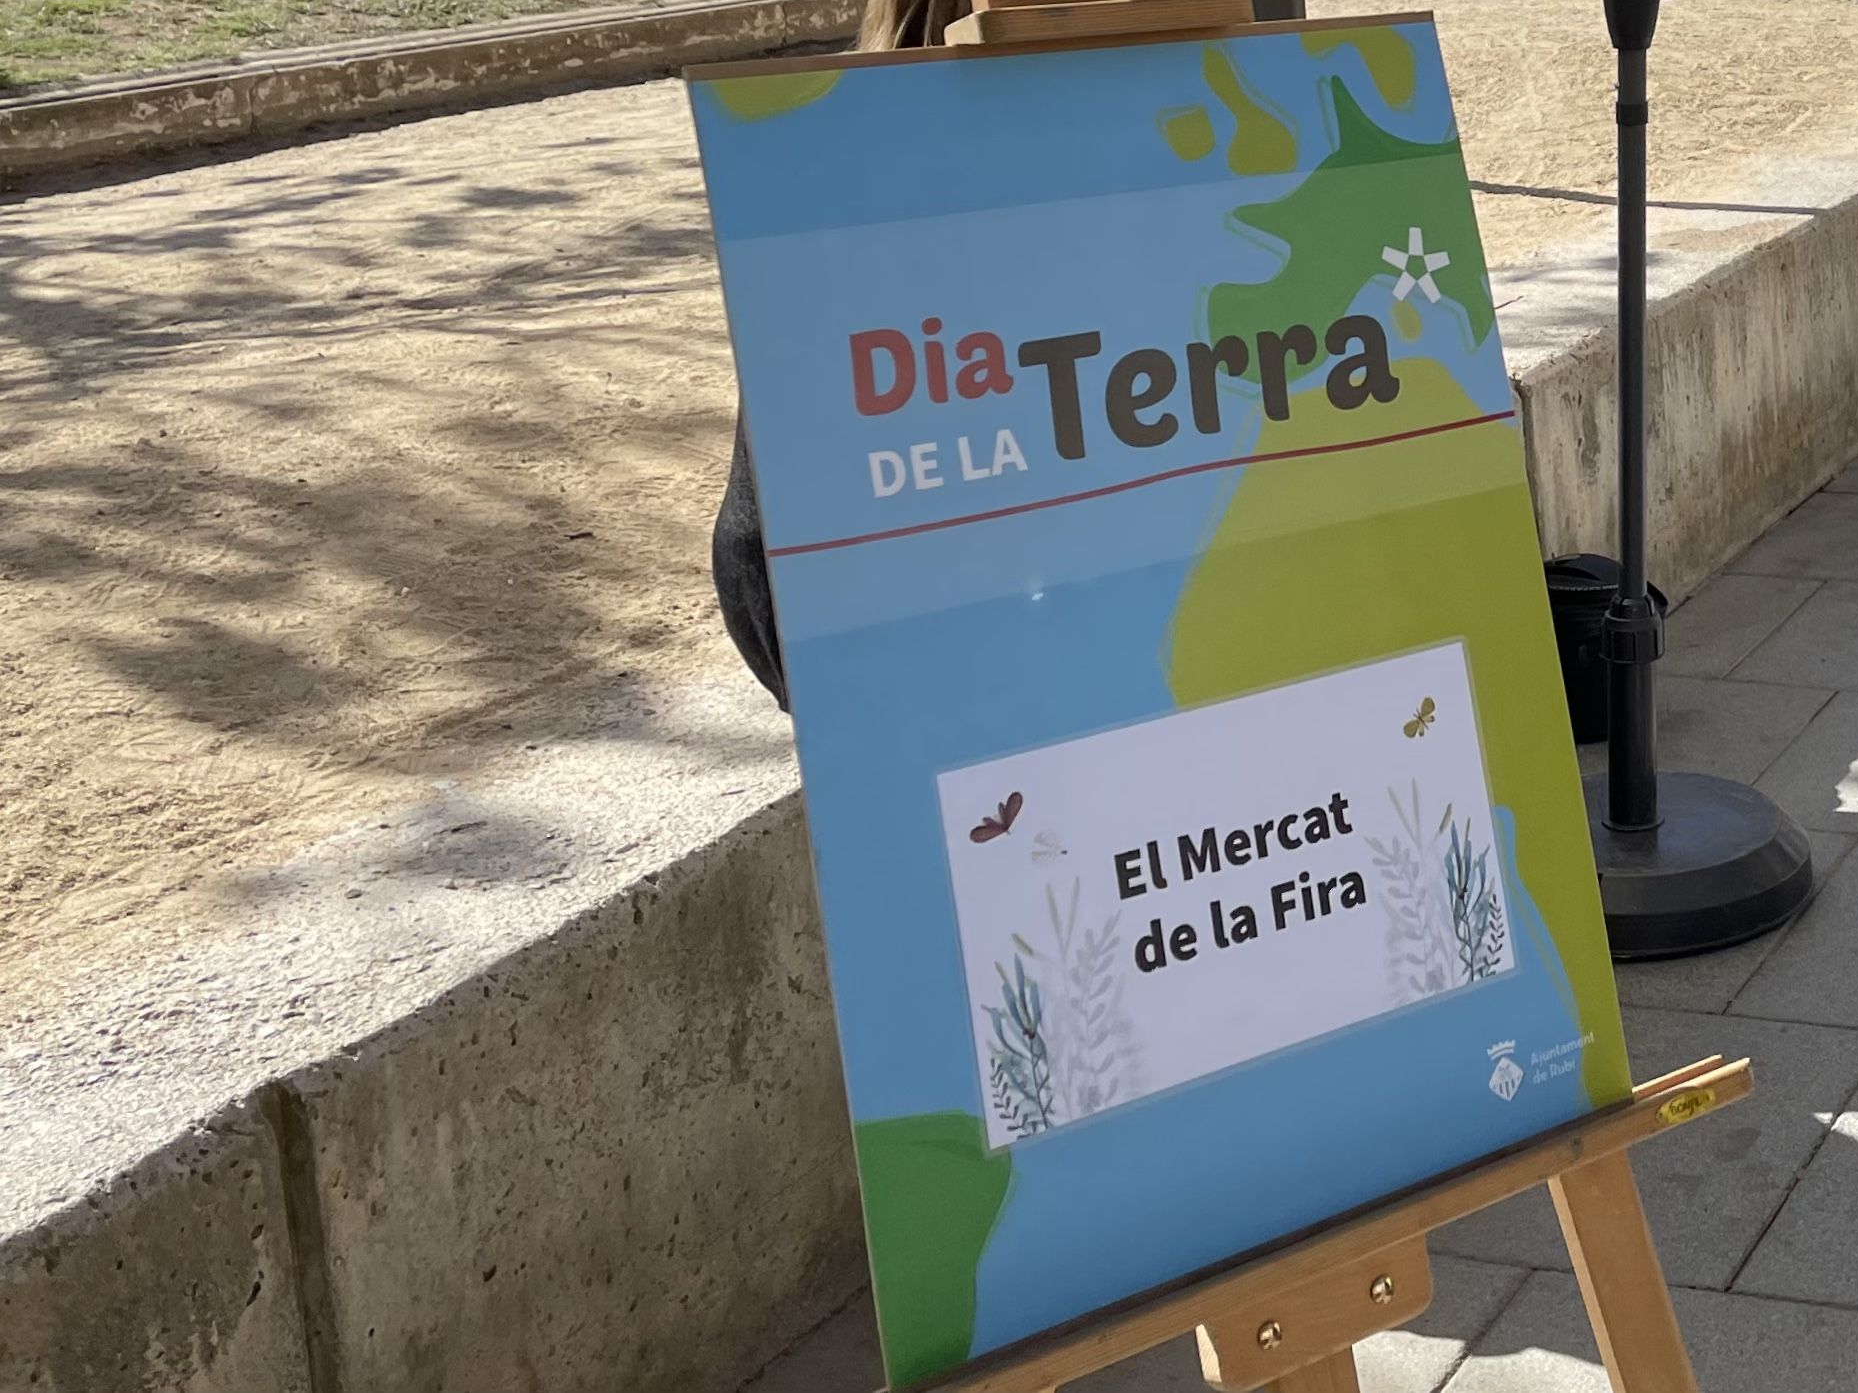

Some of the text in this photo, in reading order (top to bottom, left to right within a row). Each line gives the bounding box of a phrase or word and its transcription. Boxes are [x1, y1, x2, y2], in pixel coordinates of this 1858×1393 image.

[849, 316, 1014, 416] Dia
[1018, 312, 1400, 460] Terra
[868, 429, 1028, 498] DE LA
[1113, 791, 1354, 900] El Mercat
[1133, 864, 1368, 973] de la Fira
[1531, 1032, 1595, 1066] Ajuntament
[1533, 1069, 1548, 1085] de
